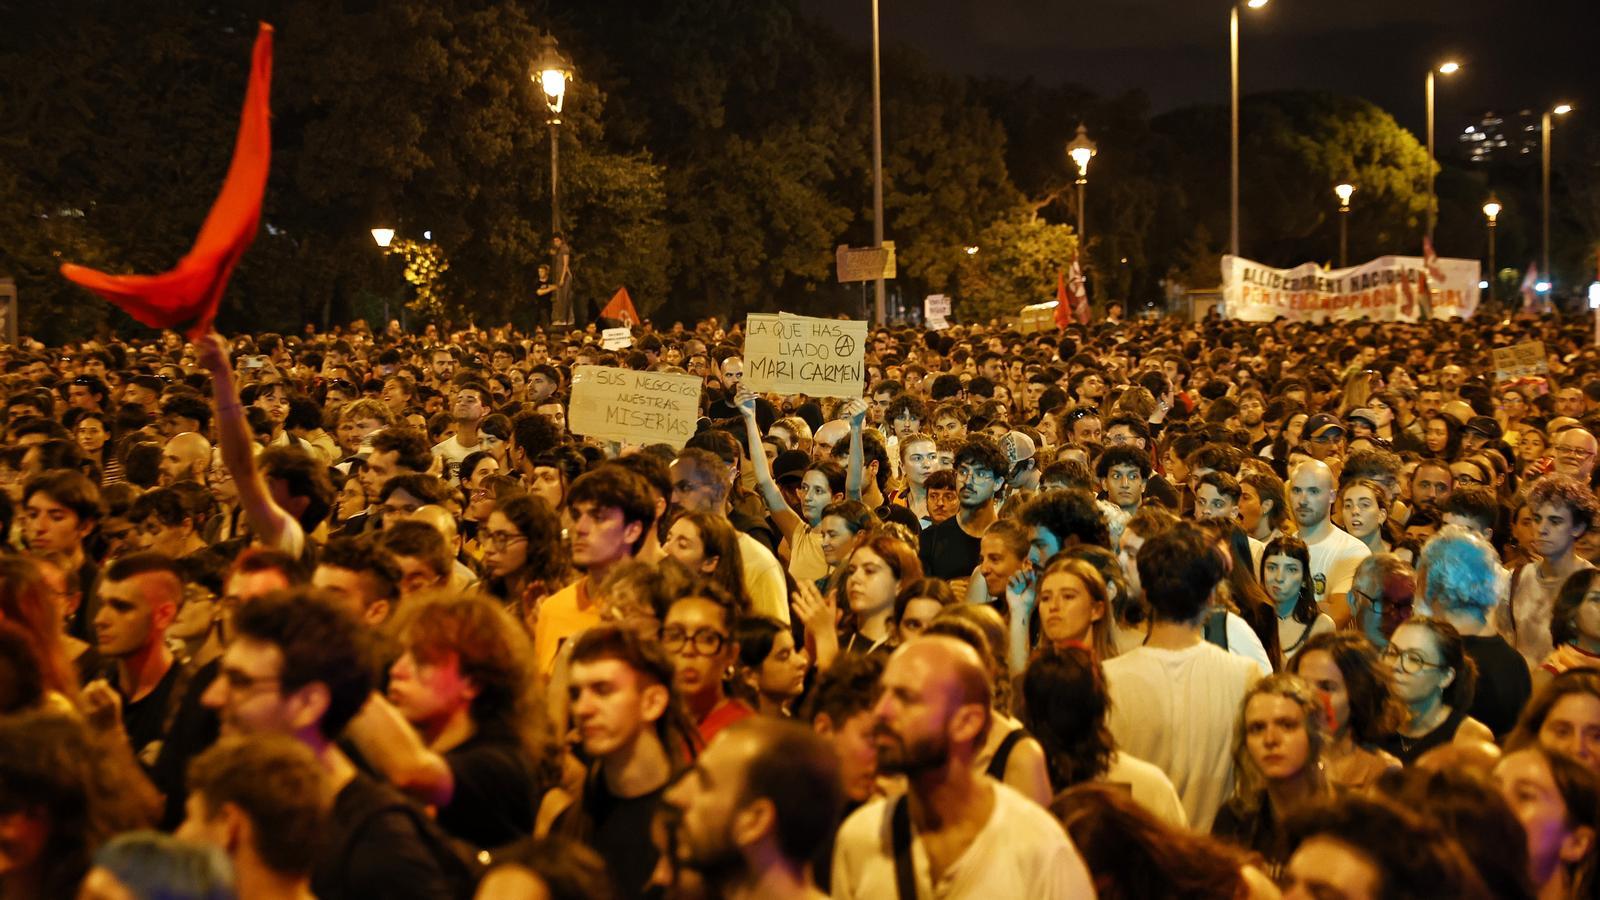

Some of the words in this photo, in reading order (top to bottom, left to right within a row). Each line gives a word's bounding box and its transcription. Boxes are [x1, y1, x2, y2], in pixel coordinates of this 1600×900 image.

[748, 320, 767, 335] LA
[772, 320, 802, 340] QUE
[812, 323, 842, 337] HAS
[778, 342, 830, 360] LIADO
[596, 370, 626, 386] SUS
[750, 356, 794, 380] MARI
[799, 360, 861, 384] CARMEN
[616, 393, 681, 411] NUESTRAS
